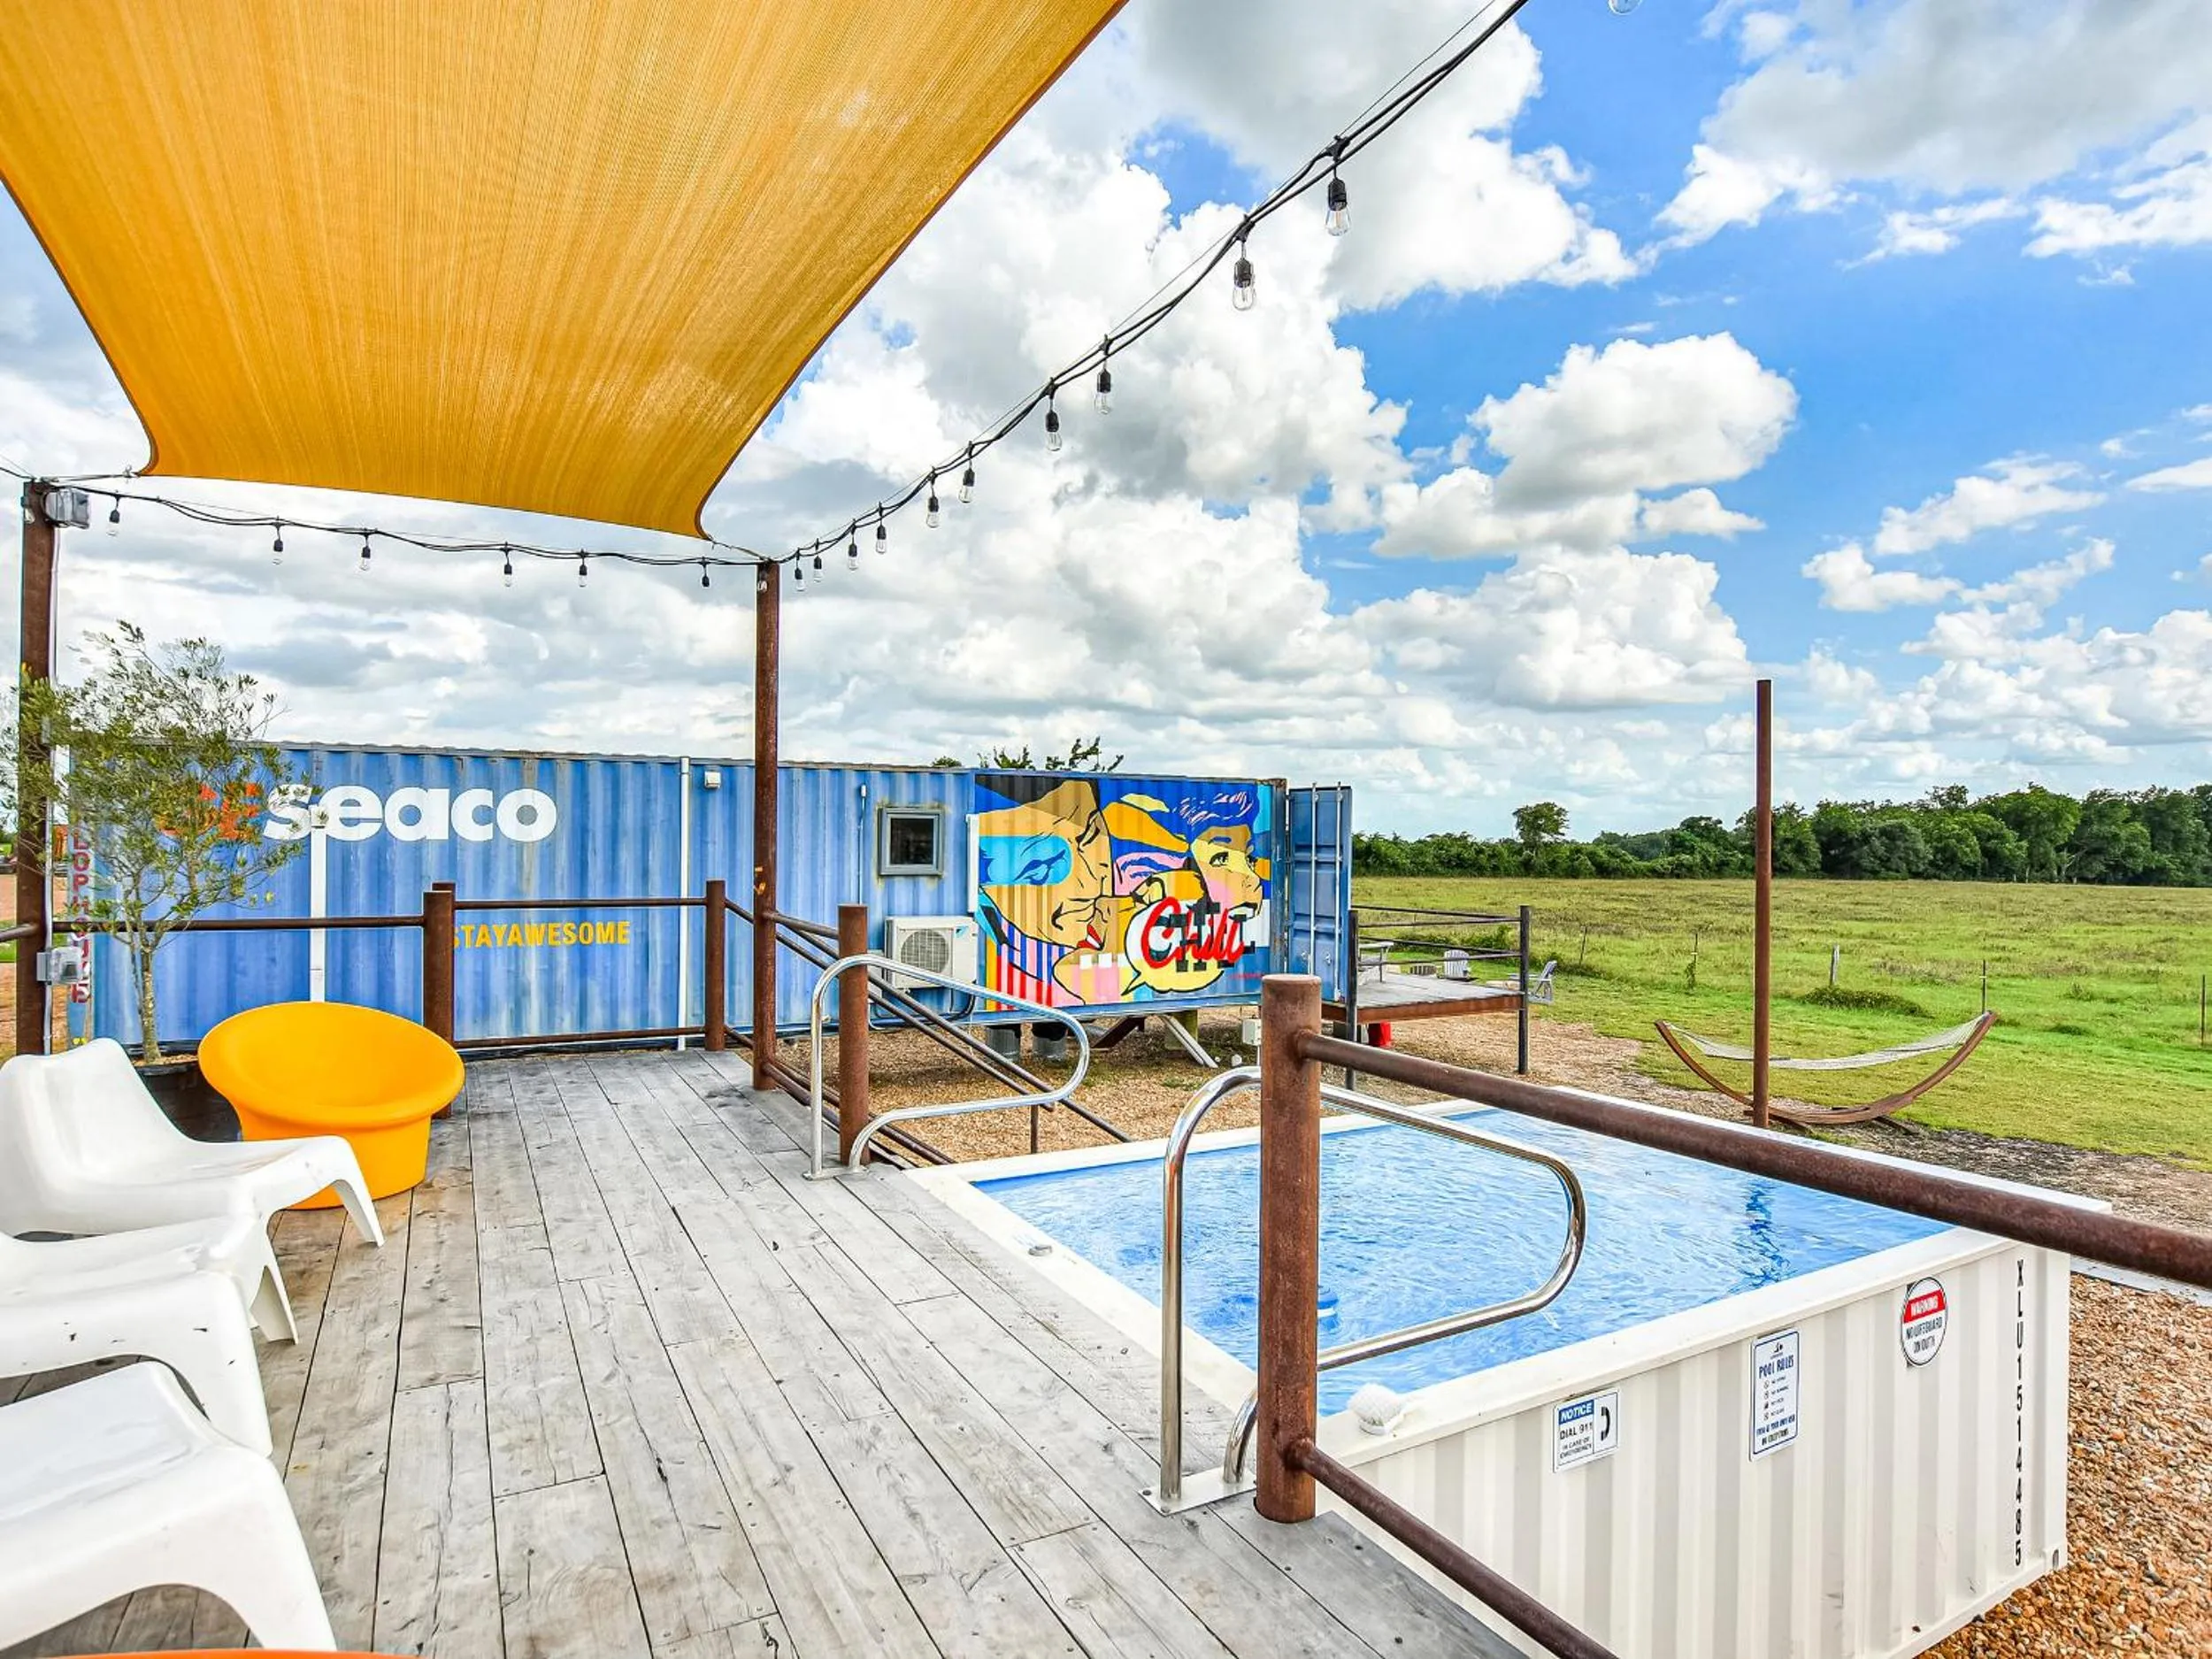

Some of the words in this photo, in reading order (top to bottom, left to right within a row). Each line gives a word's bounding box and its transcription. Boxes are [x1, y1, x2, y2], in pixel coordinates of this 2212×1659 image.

[264, 783, 557, 842] seaco
[1560, 1402, 1593, 1423] NOTICE
[1559, 1426, 1577, 1440] DIAL
[1579, 1422, 1593, 1434] 911
